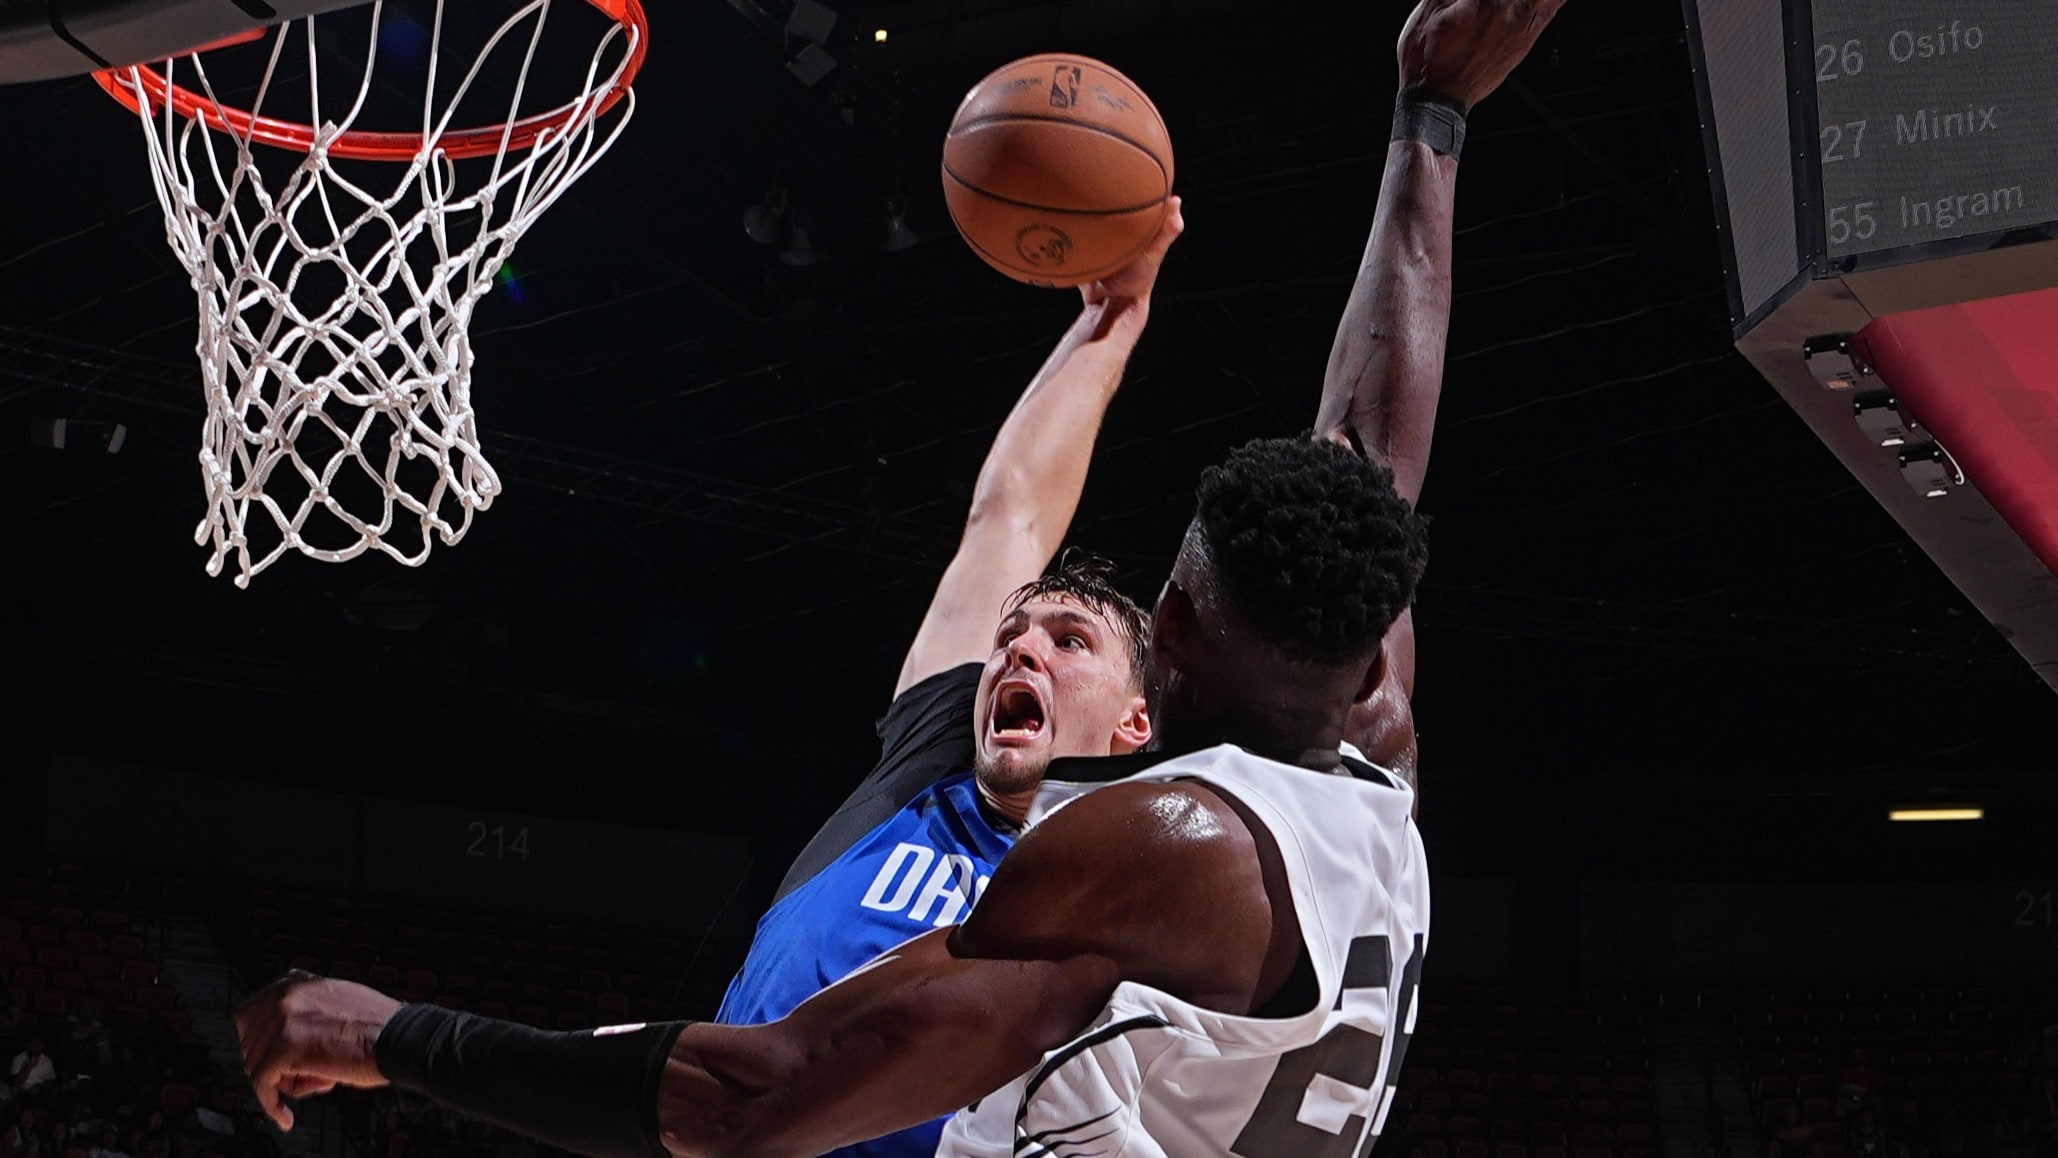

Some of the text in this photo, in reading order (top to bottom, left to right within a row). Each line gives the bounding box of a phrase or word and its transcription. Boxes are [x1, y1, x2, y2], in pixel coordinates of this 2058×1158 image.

[1815, 21, 1984, 82] 26 Osifo
[1820, 104, 1999, 164] 27 Minix
[1829, 186, 2024, 243] 55 Ingram
[467, 821, 531, 862] 214
